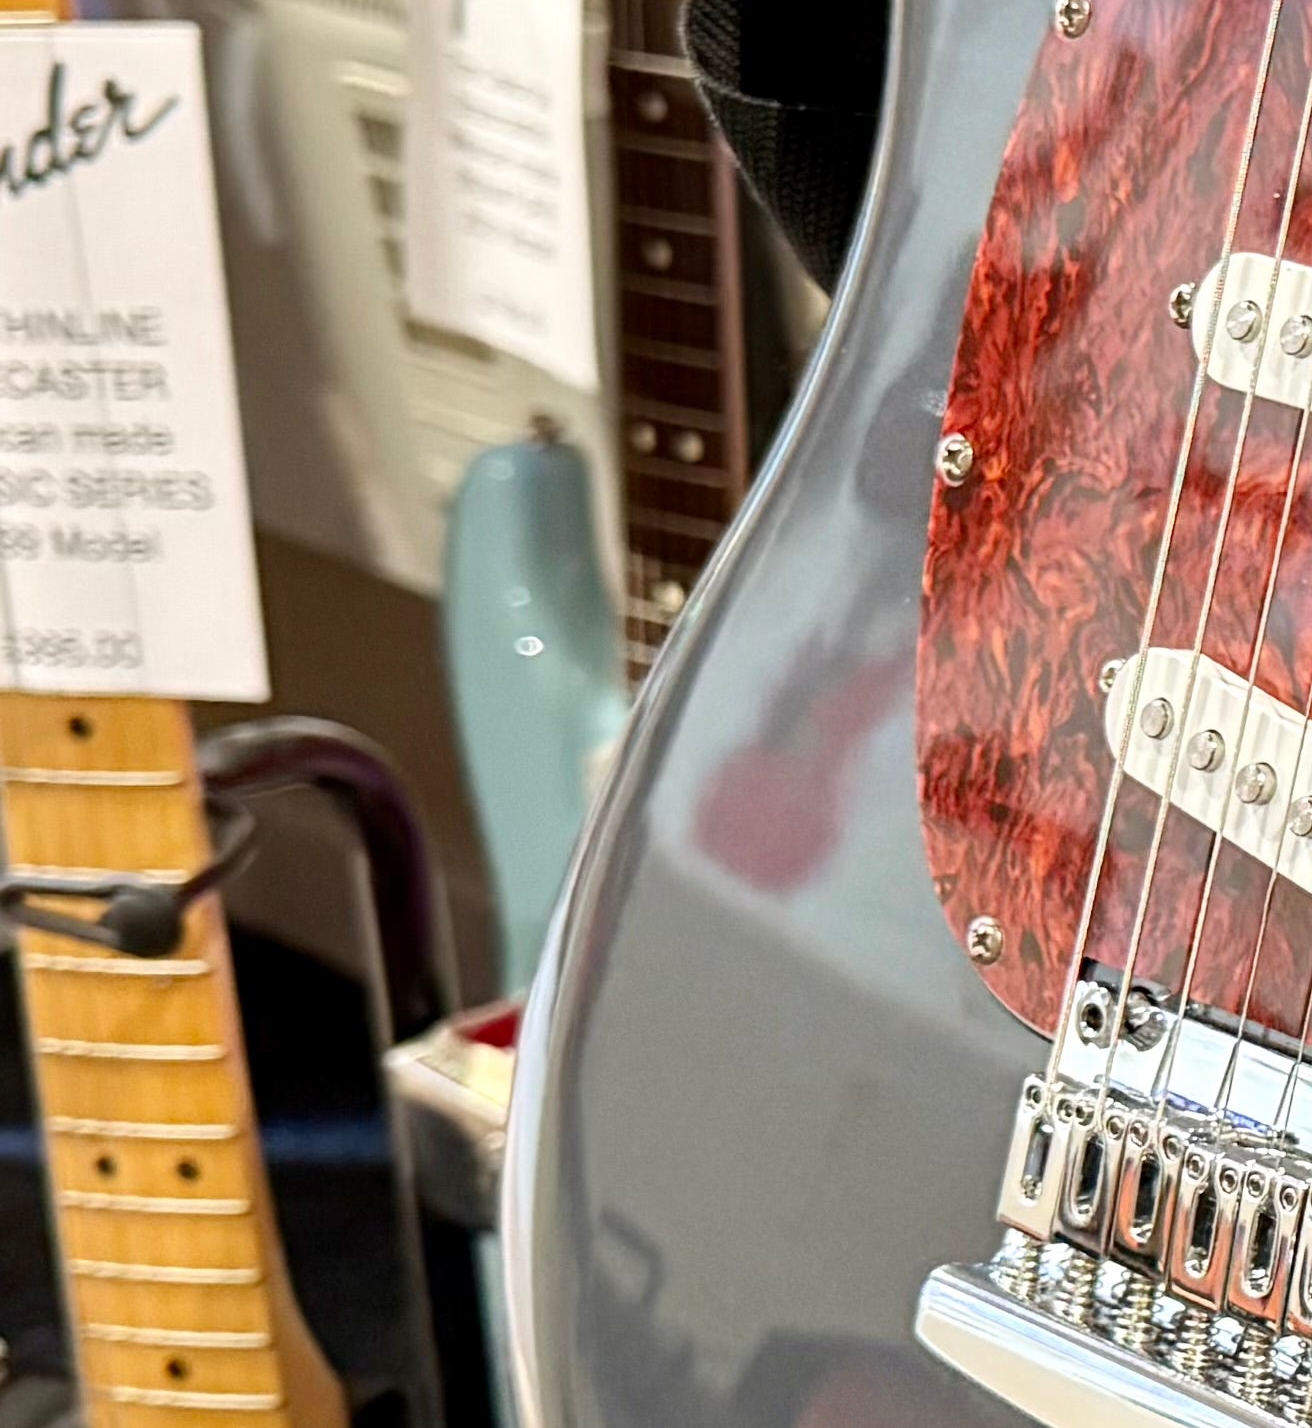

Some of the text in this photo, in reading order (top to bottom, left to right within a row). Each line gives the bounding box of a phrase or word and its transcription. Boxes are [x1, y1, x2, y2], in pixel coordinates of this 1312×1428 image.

[0, 306, 169, 347] HINLINE
[70, 421, 175, 456] made
[49, 523, 164, 563] Model
